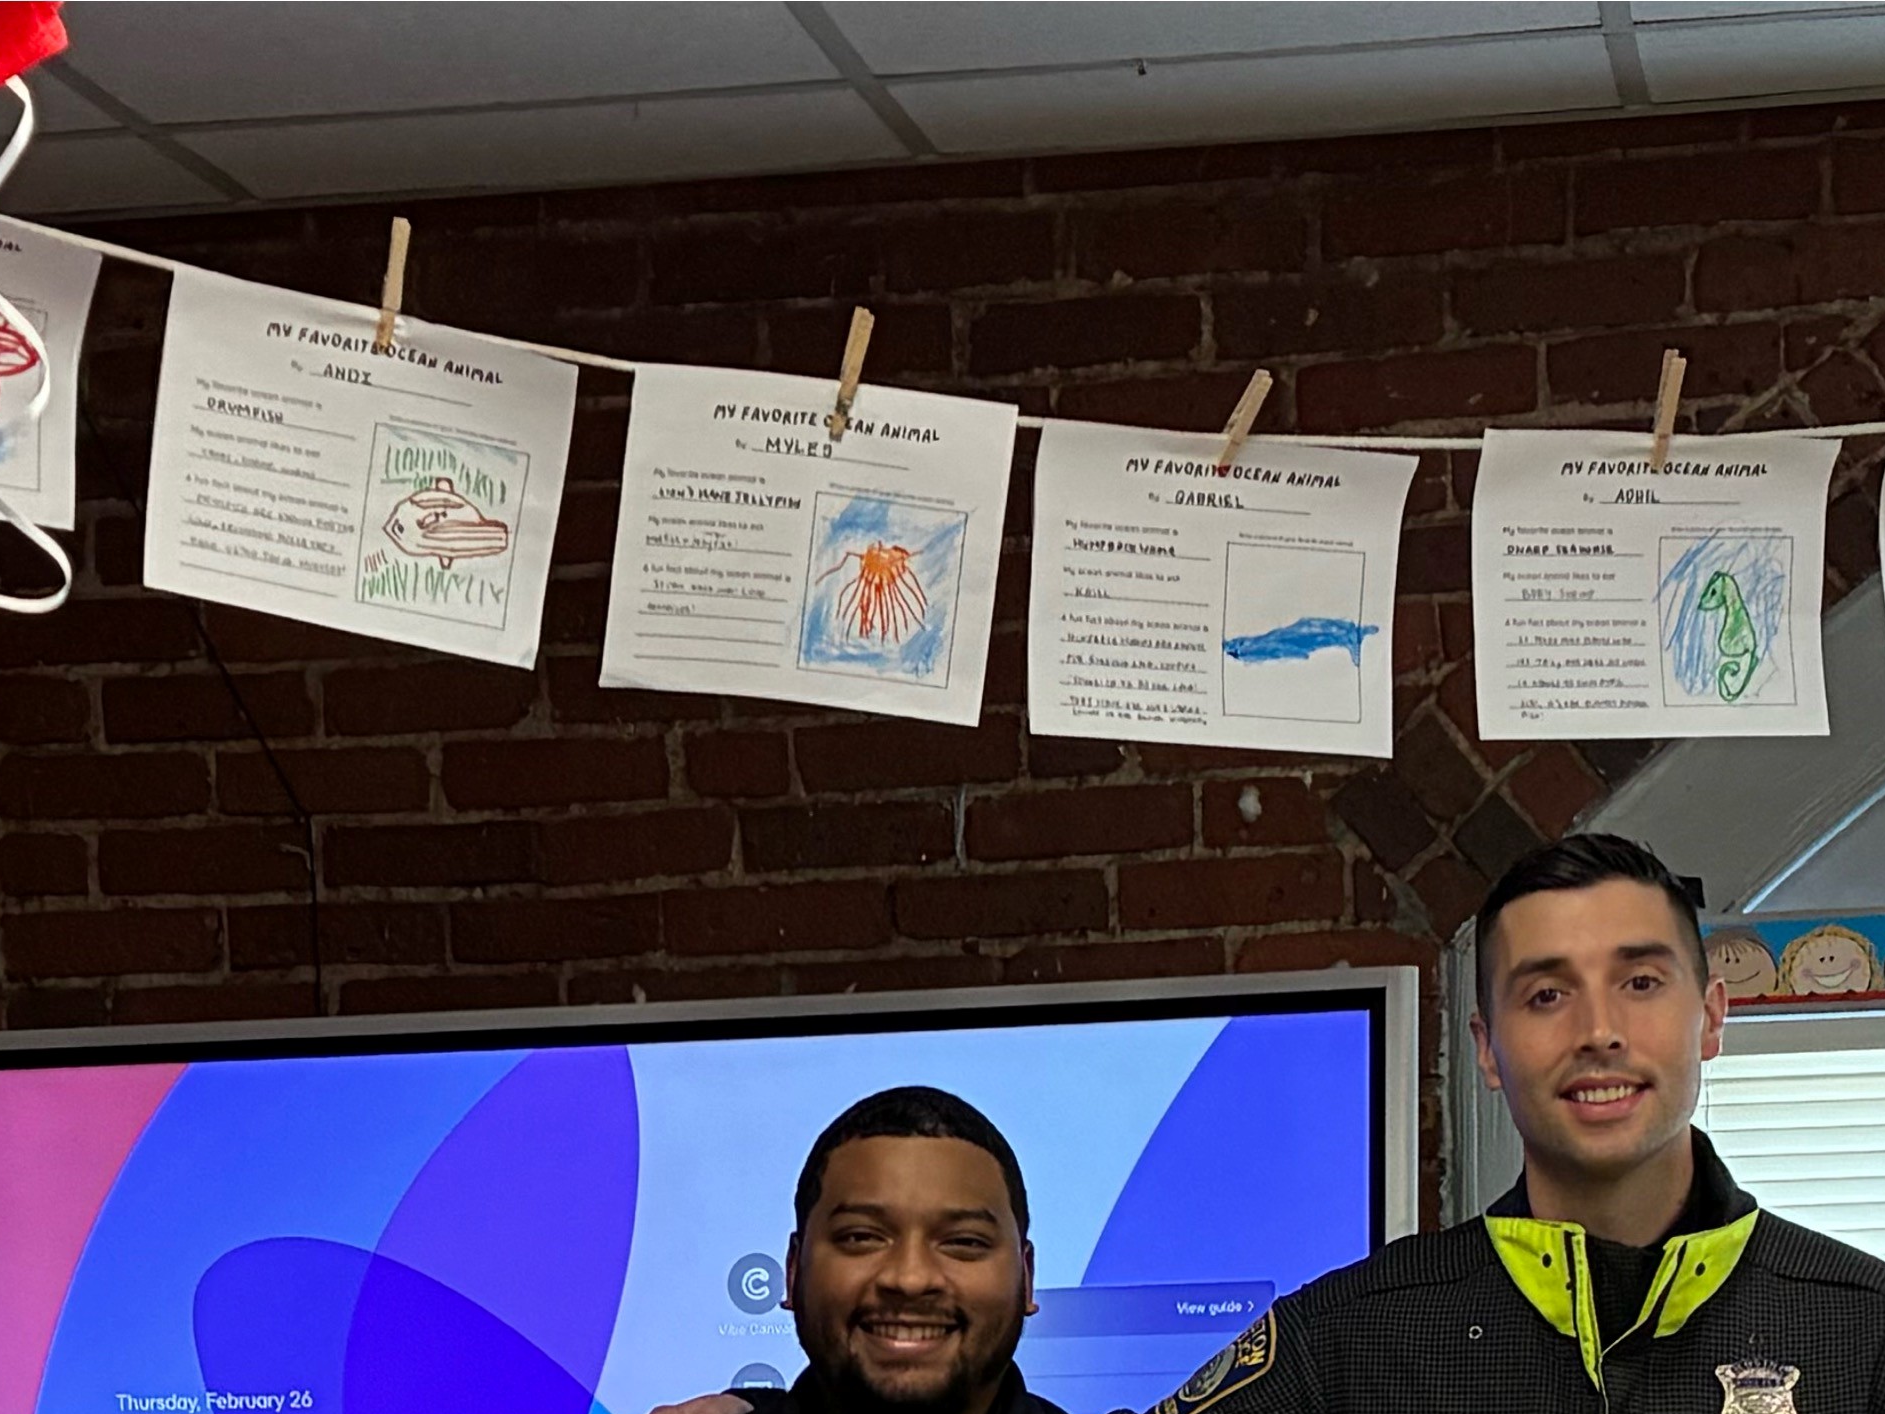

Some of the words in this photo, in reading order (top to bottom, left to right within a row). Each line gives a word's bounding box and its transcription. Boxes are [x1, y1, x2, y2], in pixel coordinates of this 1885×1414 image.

[267, 322, 292, 338] MY
[384, 344, 438, 369] OCEAN
[443, 360, 503, 385] ANIMAL
[322, 363, 373, 386] ANDI
[714, 405, 736, 420] MY
[742, 406, 817, 427] FAVORITE
[880, 423, 939, 443] ANIMAL
[1126, 458, 1149, 473] MY
[1154, 459, 1229, 478] FAVORIT
[1233, 465, 1280, 484] OCEAN
[1286, 472, 1341, 488] ANIMAL
[1561, 462, 1583, 476] MY
[1663, 462, 1710, 476] OCEAN
[1715, 463, 1767, 477] ANIMAL
[1614, 489, 1661, 504] ADHIL
[1176, 1302, 1205, 1314] View
[1209, 1301, 1243, 1316] guide
[115, 1394, 201, 1414] Thursday,
[206, 1392, 285, 1413] February
[289, 1390, 313, 1408] 26
